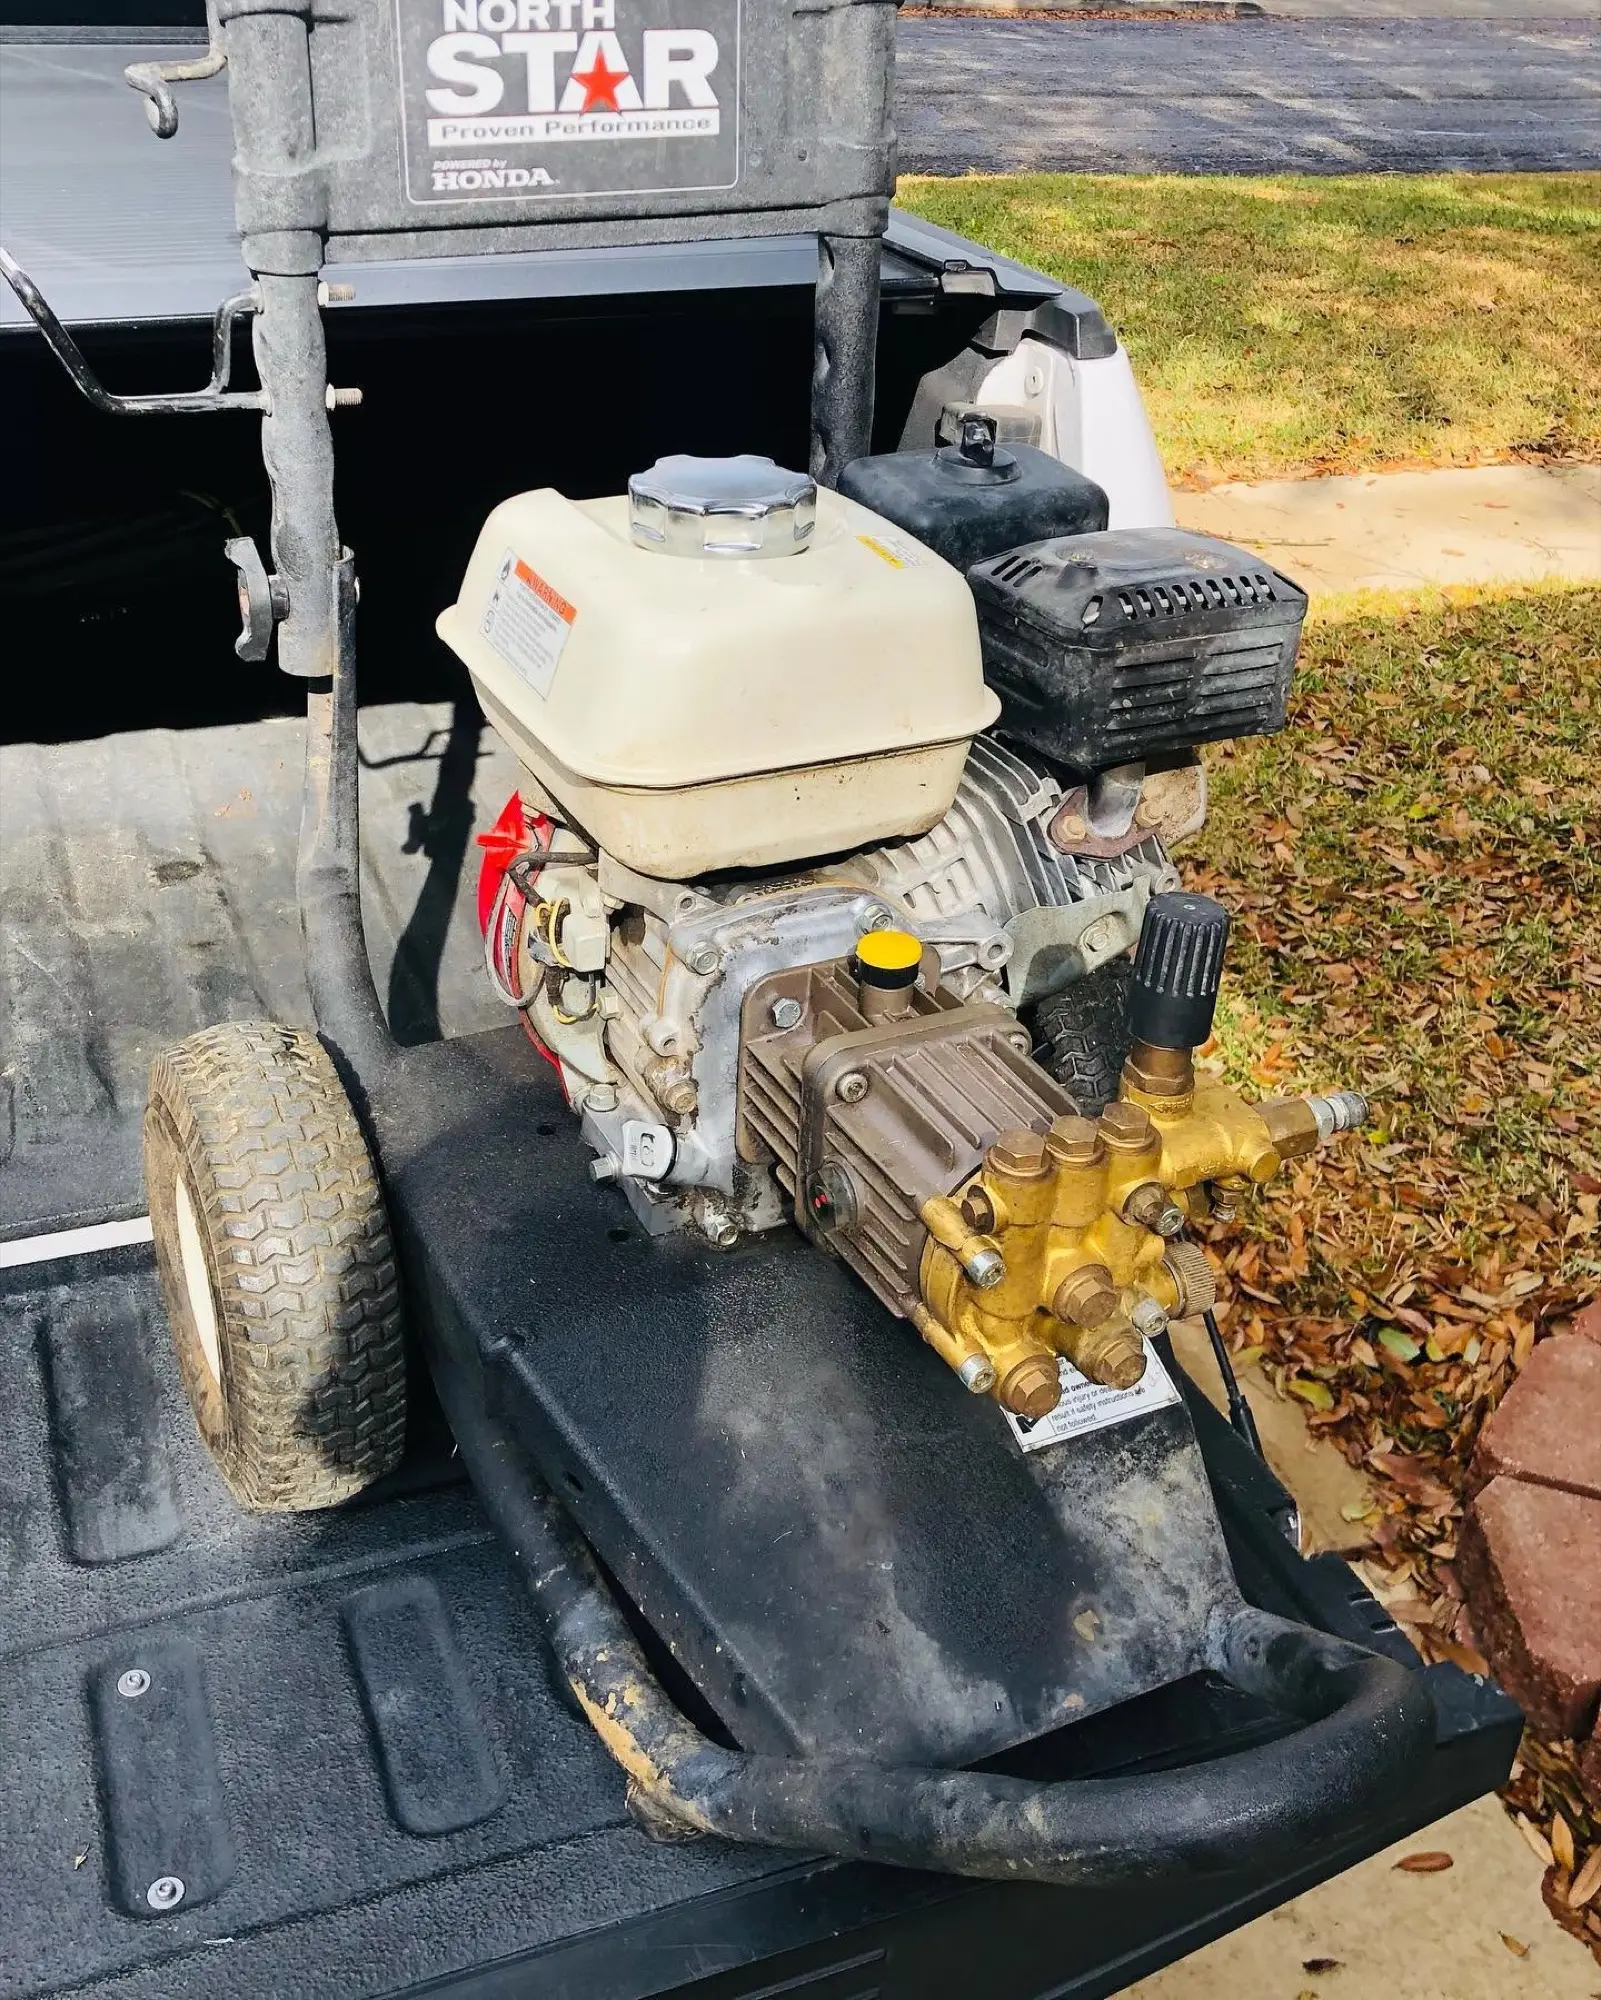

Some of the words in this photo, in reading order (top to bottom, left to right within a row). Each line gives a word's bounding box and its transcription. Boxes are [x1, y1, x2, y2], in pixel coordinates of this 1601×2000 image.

[443, 0, 615, 32] NORTH
[425, 29, 719, 115] STAR
[441, 122, 534, 140] Proven
[545, 117, 712, 136] Performance
[433, 159, 491, 170] POWERED
[492, 158, 507, 169] by
[431, 167, 555, 191] HONDA
[532, 574, 567, 615] WARNING
[1076, 1402, 1097, 1414] safety
[1056, 1423, 1069, 1433] not
